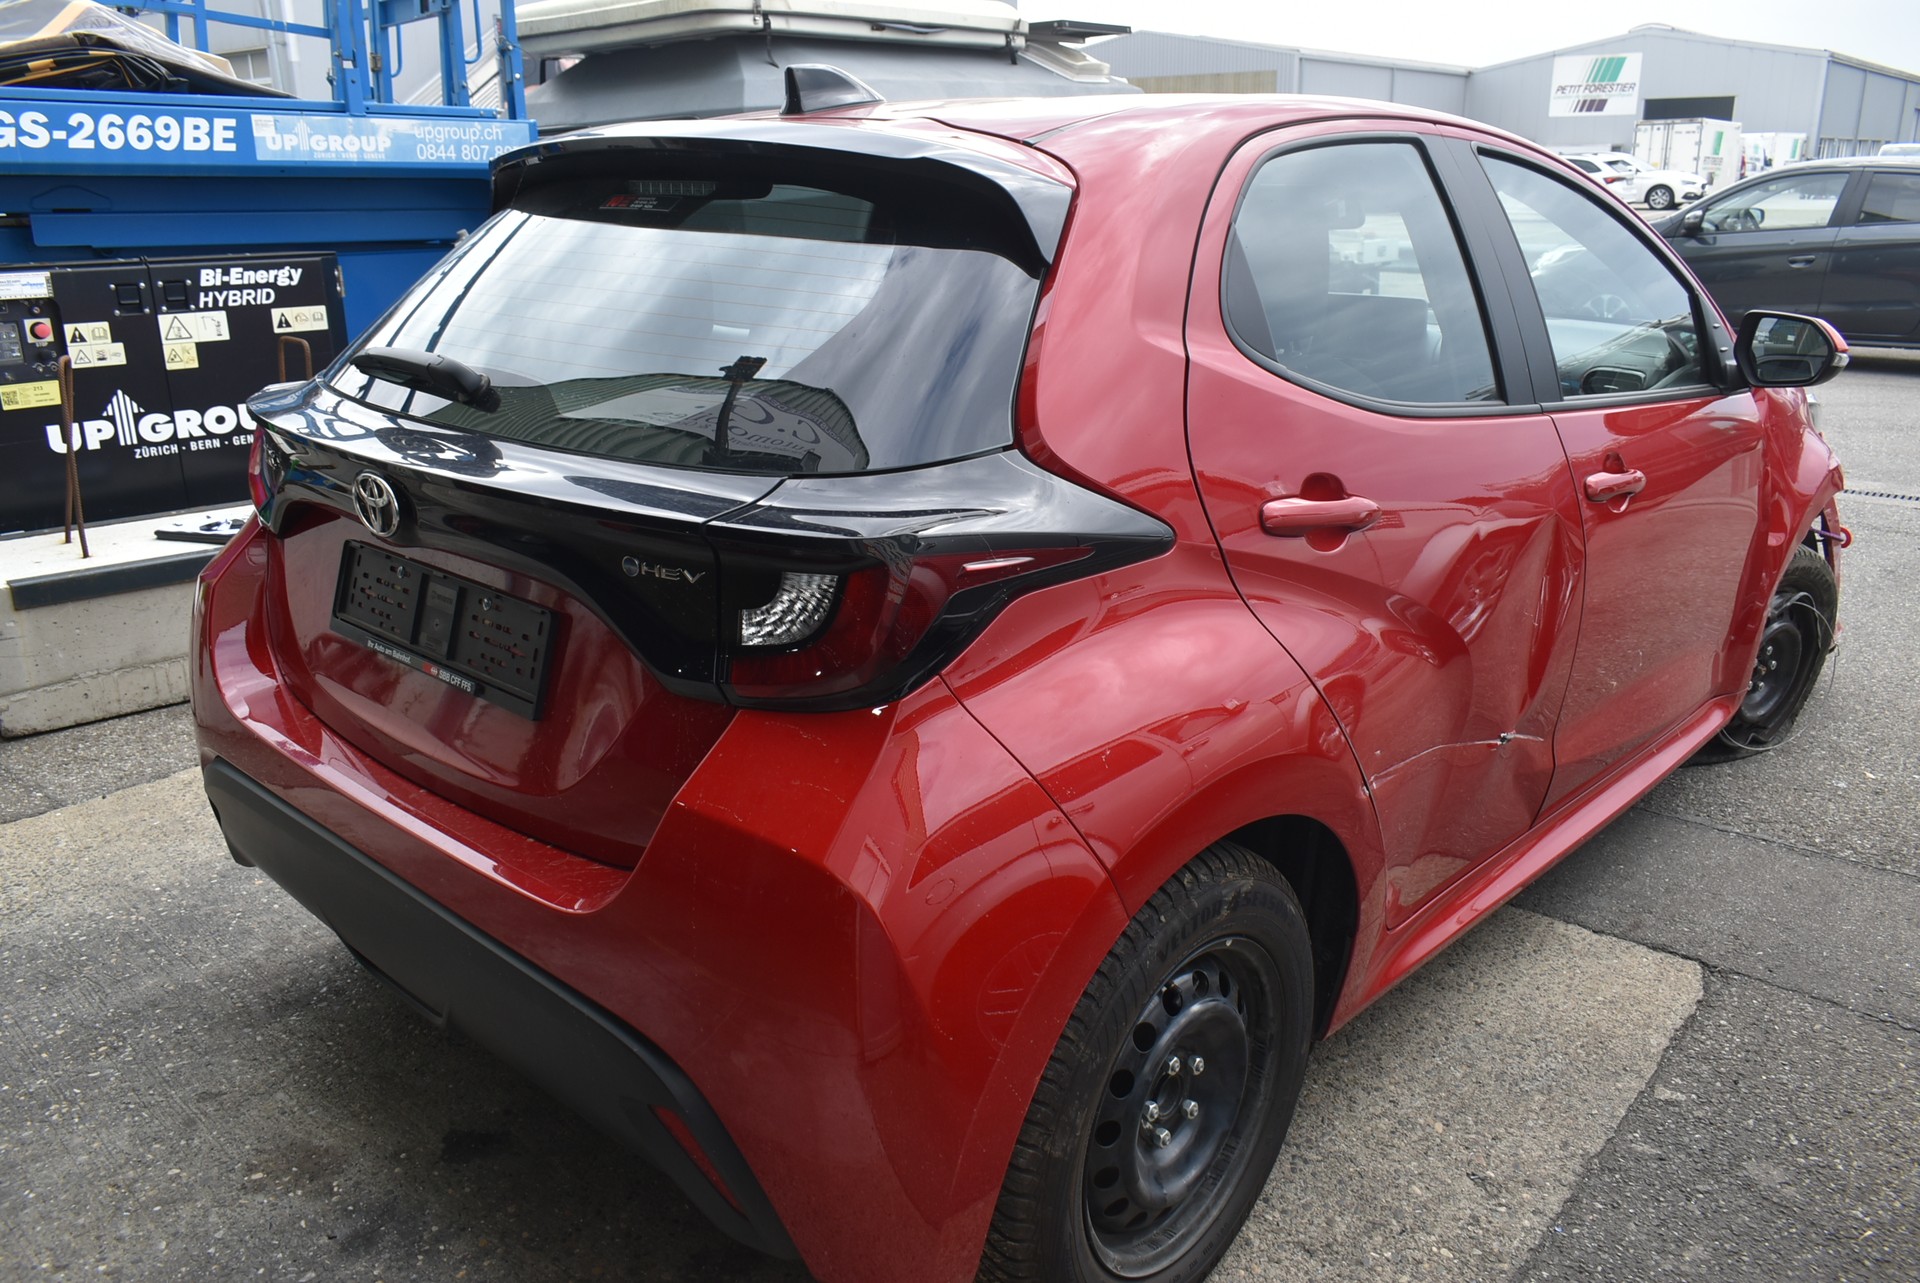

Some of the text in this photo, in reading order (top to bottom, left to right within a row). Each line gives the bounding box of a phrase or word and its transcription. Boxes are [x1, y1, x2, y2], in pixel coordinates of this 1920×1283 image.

[1555, 82, 1637, 95] PETIT FORESTIER
[310, 133, 392, 153] GROUP
[414, 124, 503, 143] upgroup.ch
[416, 144, 457, 161] 0844
[200, 266, 302, 287] Bi-Energy
[199, 288, 275, 308] HYBRID
[138, 403, 257, 443] GROU
[134, 434, 255, 459] ZÜRICH BERN GEN
[641, 561, 706, 583] HEV
[374, 641, 385, 653] Auto
[438, 670, 472, 692] SBB CFF FFS
